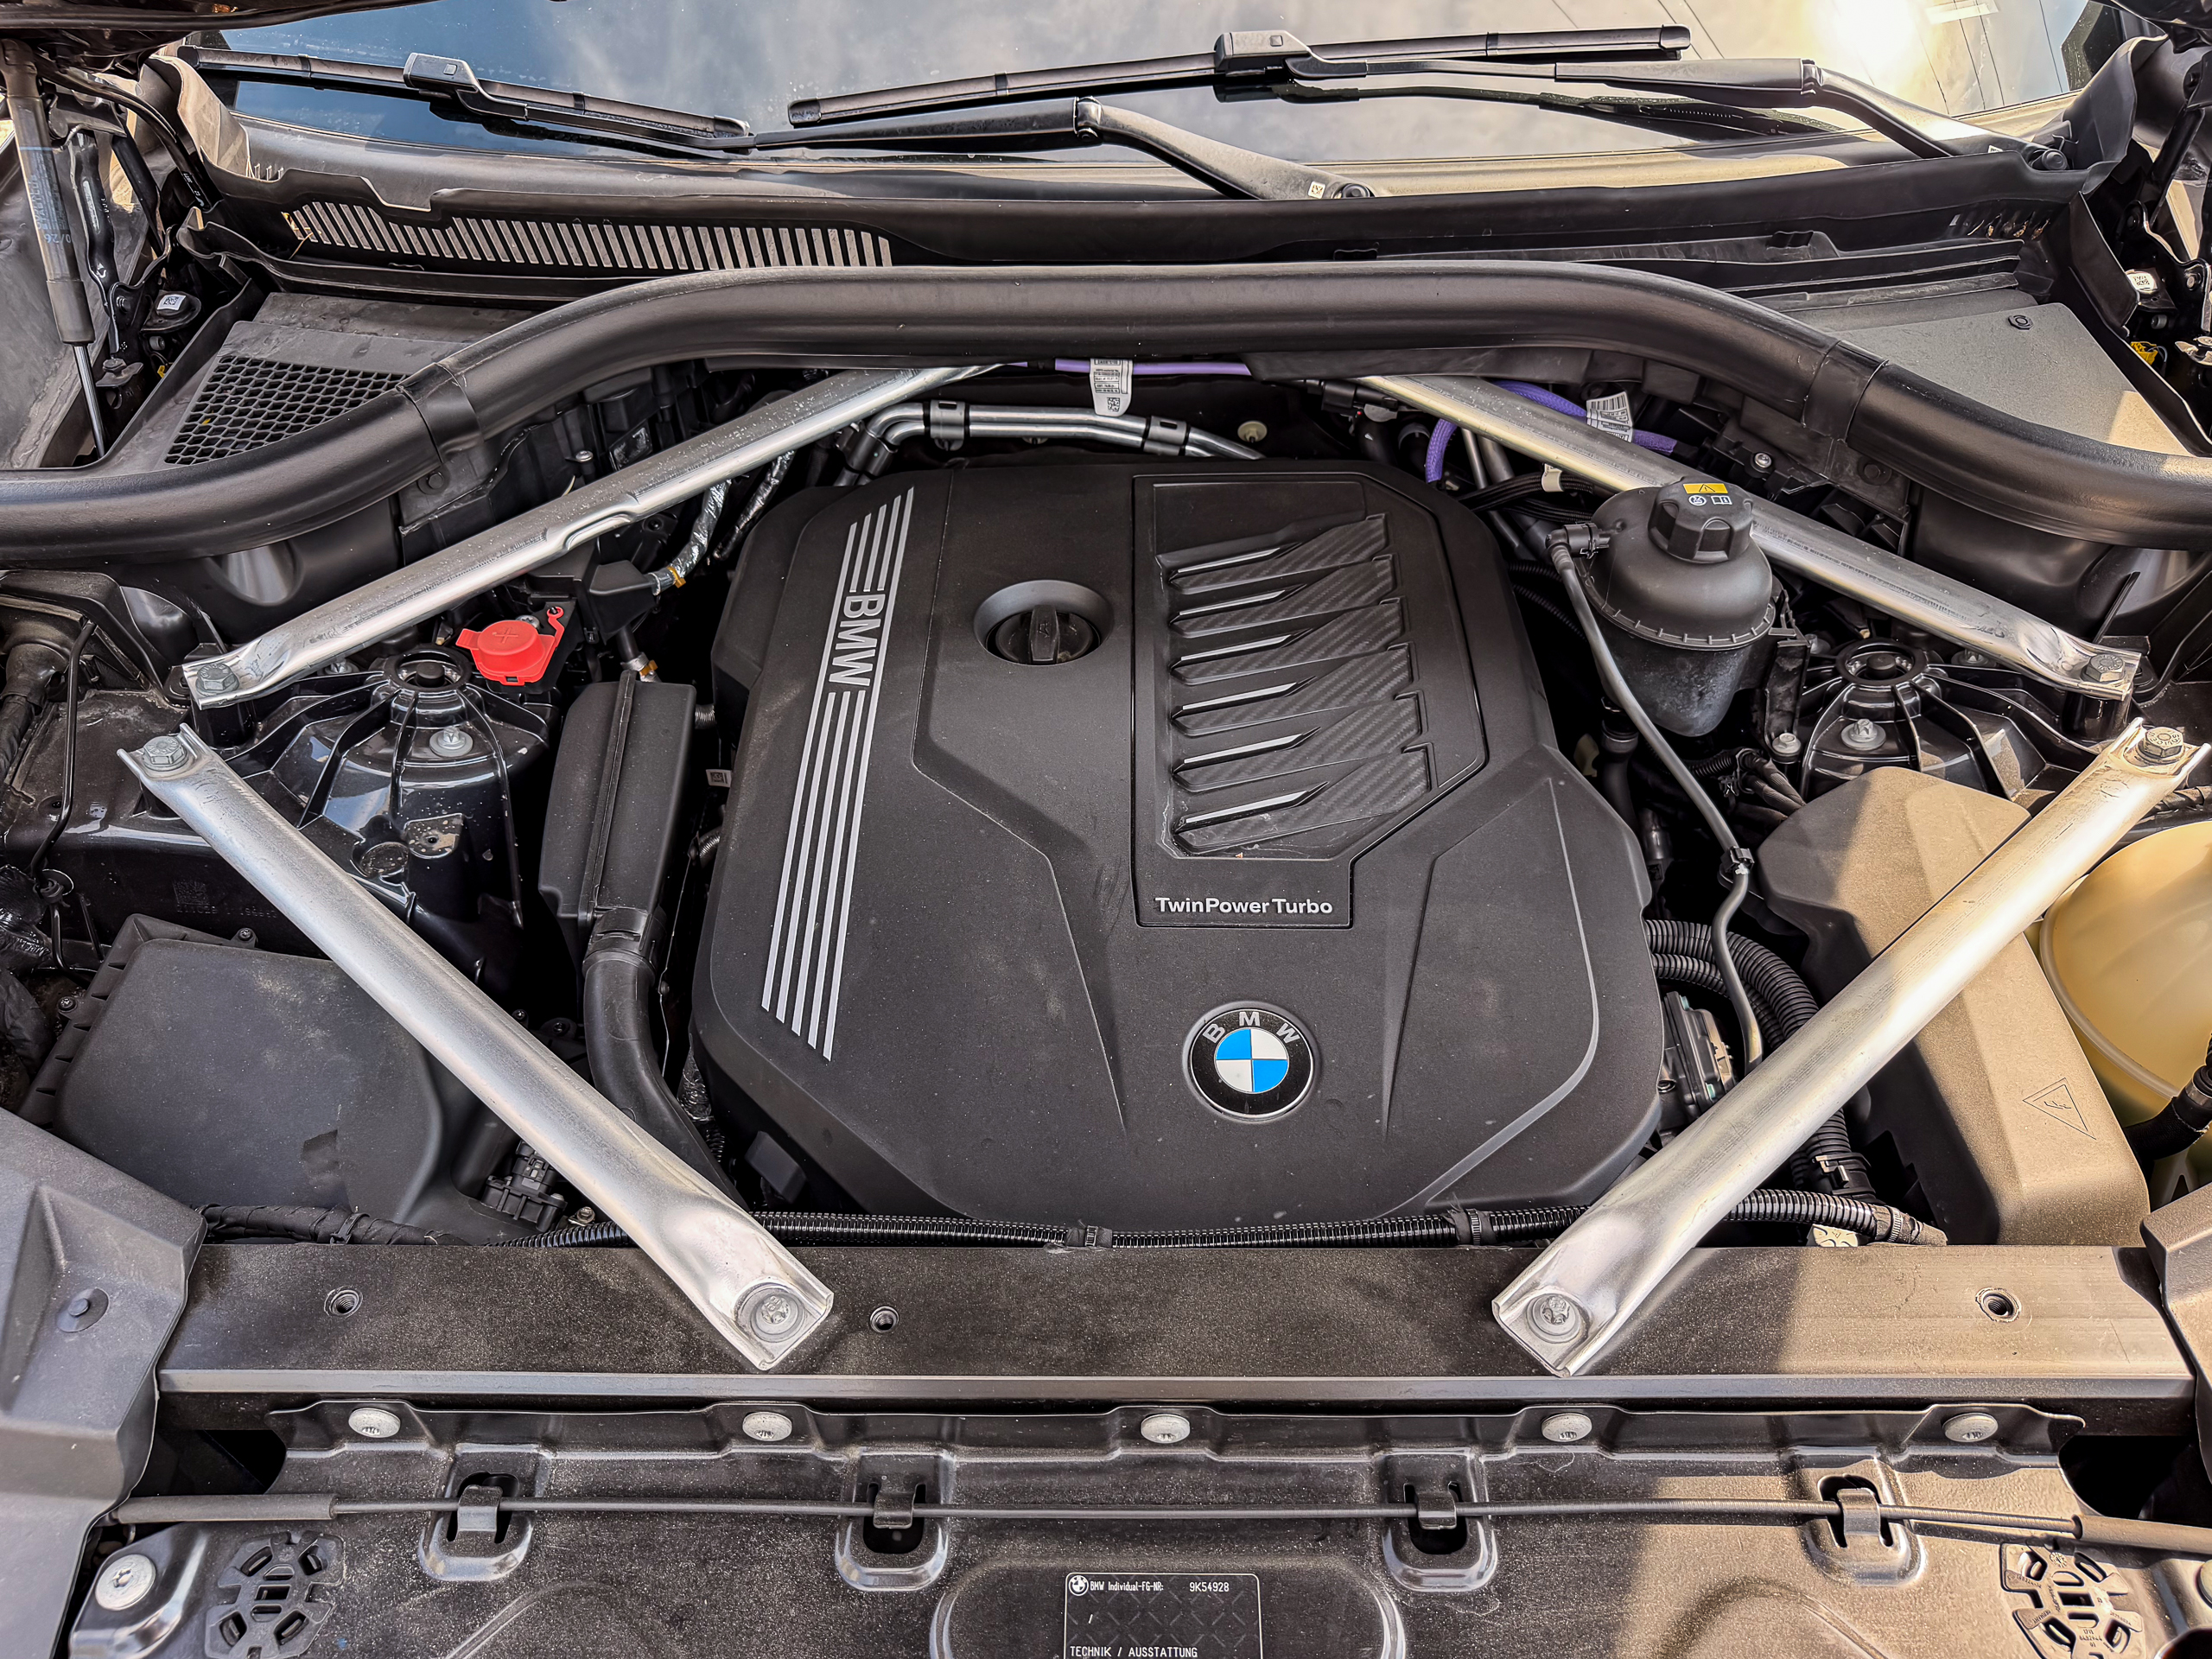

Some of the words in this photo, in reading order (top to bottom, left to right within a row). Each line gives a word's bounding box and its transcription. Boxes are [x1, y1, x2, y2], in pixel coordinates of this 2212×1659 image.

[828, 594, 886, 687] BMW
[1154, 897, 1270, 914] TwinPower
[1271, 898, 1333, 914] Turbo
[1202, 1010, 1300, 1045] BMW
[1090, 1580, 1105, 1592] BMW
[1189, 1582, 1230, 1592] 9K54928
[1069, 1645, 1113, 1657] TECHNIK
[1128, 1646, 1198, 1658] AUSSTATTUNG
